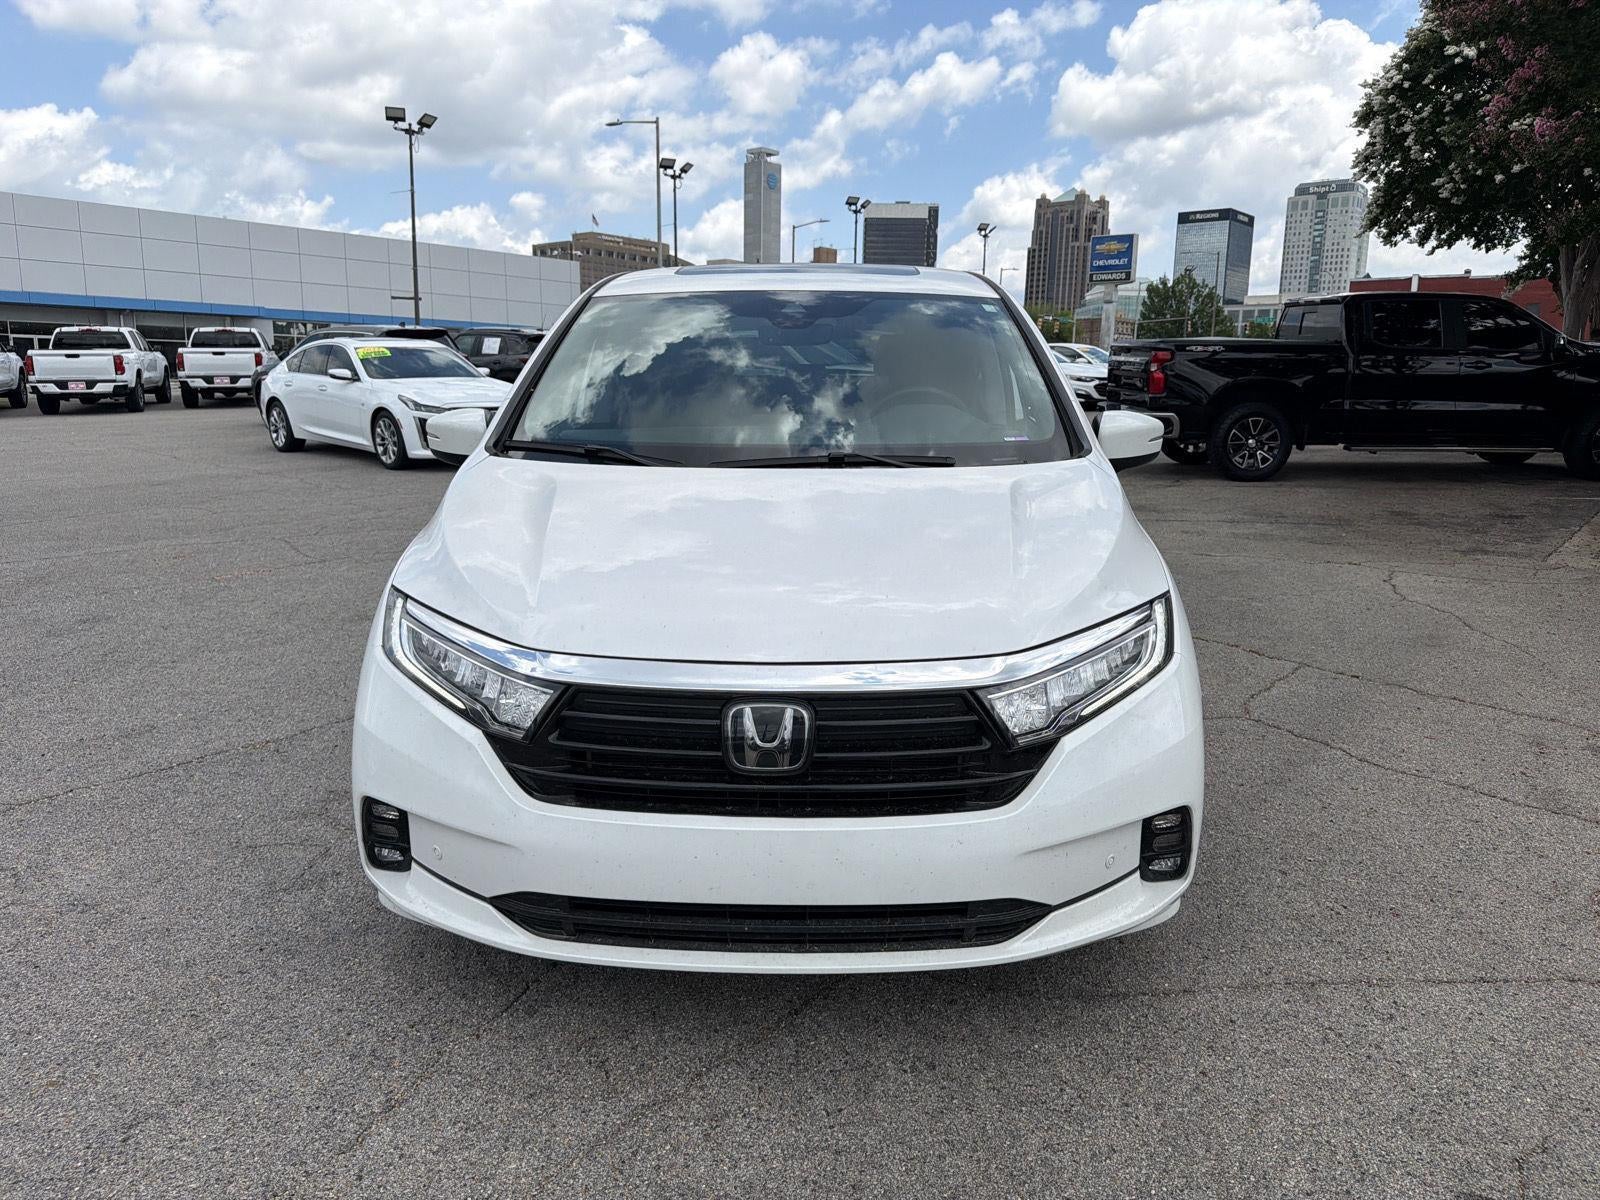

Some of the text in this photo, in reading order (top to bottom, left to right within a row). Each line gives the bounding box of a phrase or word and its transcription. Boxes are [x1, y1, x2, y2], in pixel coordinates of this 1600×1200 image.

[1309, 185, 1329, 193] Shipt
[1195, 212, 1219, 220] REGIONS
[1092, 257, 1128, 267] CHEVROLET
[1092, 272, 1126, 281] EDWARDS
